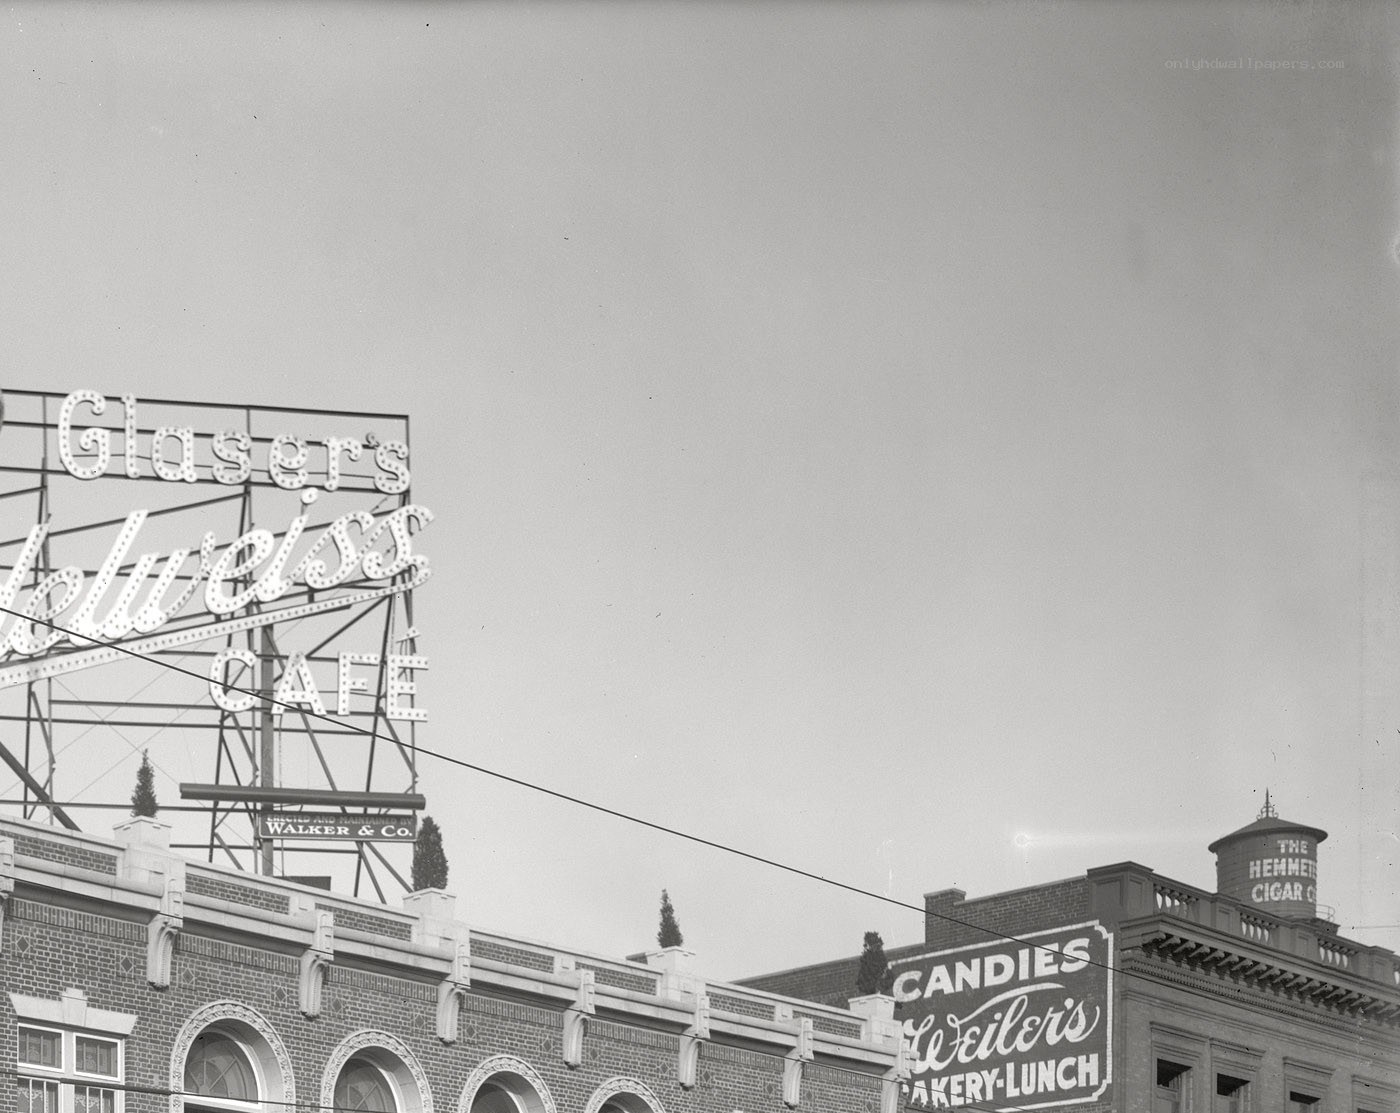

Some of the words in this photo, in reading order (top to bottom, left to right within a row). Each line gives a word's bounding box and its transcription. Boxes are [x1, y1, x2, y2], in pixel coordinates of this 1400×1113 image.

[59, 389, 410, 494] Glaser's
[358, 825, 374, 836] &
[1277, 839, 1308, 854] THE
[1251, 881, 1303, 903] CIGAR
[892, 938, 1091, 1002] CANDIES
[902, 984, 1100, 1073] Weiler's
[903, 1053, 1099, 1107] AKERY-LUNCH
